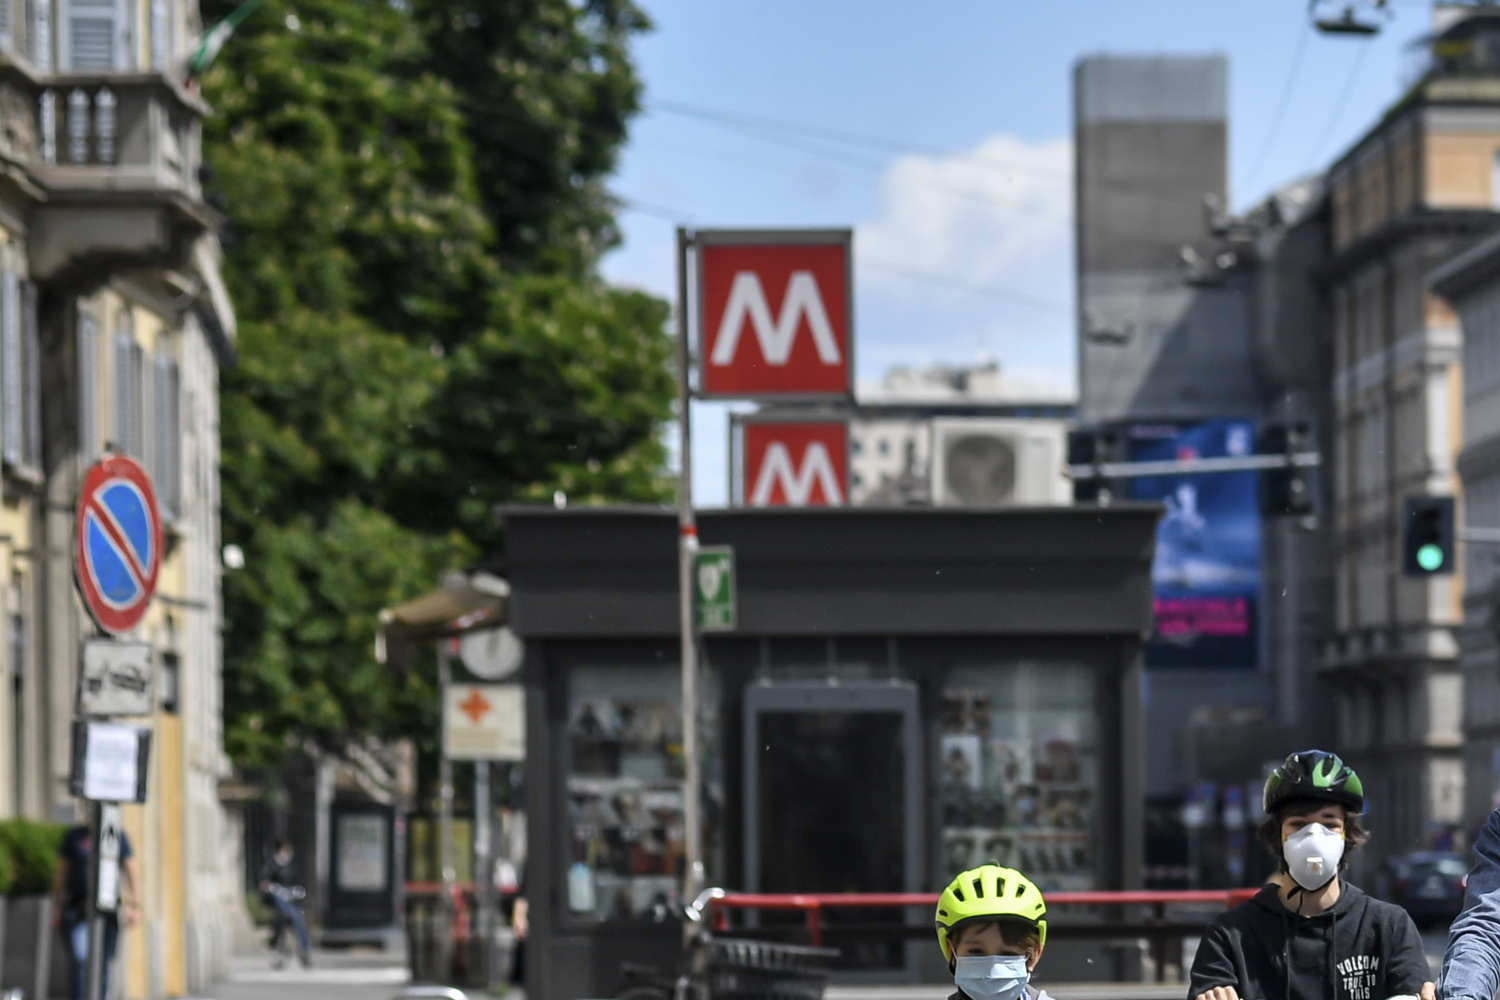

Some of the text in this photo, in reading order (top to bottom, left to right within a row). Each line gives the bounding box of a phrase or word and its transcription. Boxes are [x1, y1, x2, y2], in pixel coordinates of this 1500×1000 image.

[711, 270, 841, 366] M
[751, 441, 845, 507] M
[1336, 955, 1379, 975] VOLCOM
[1343, 974, 1376, 990] TRUE TO
[1350, 987, 1370, 1000] THIS
